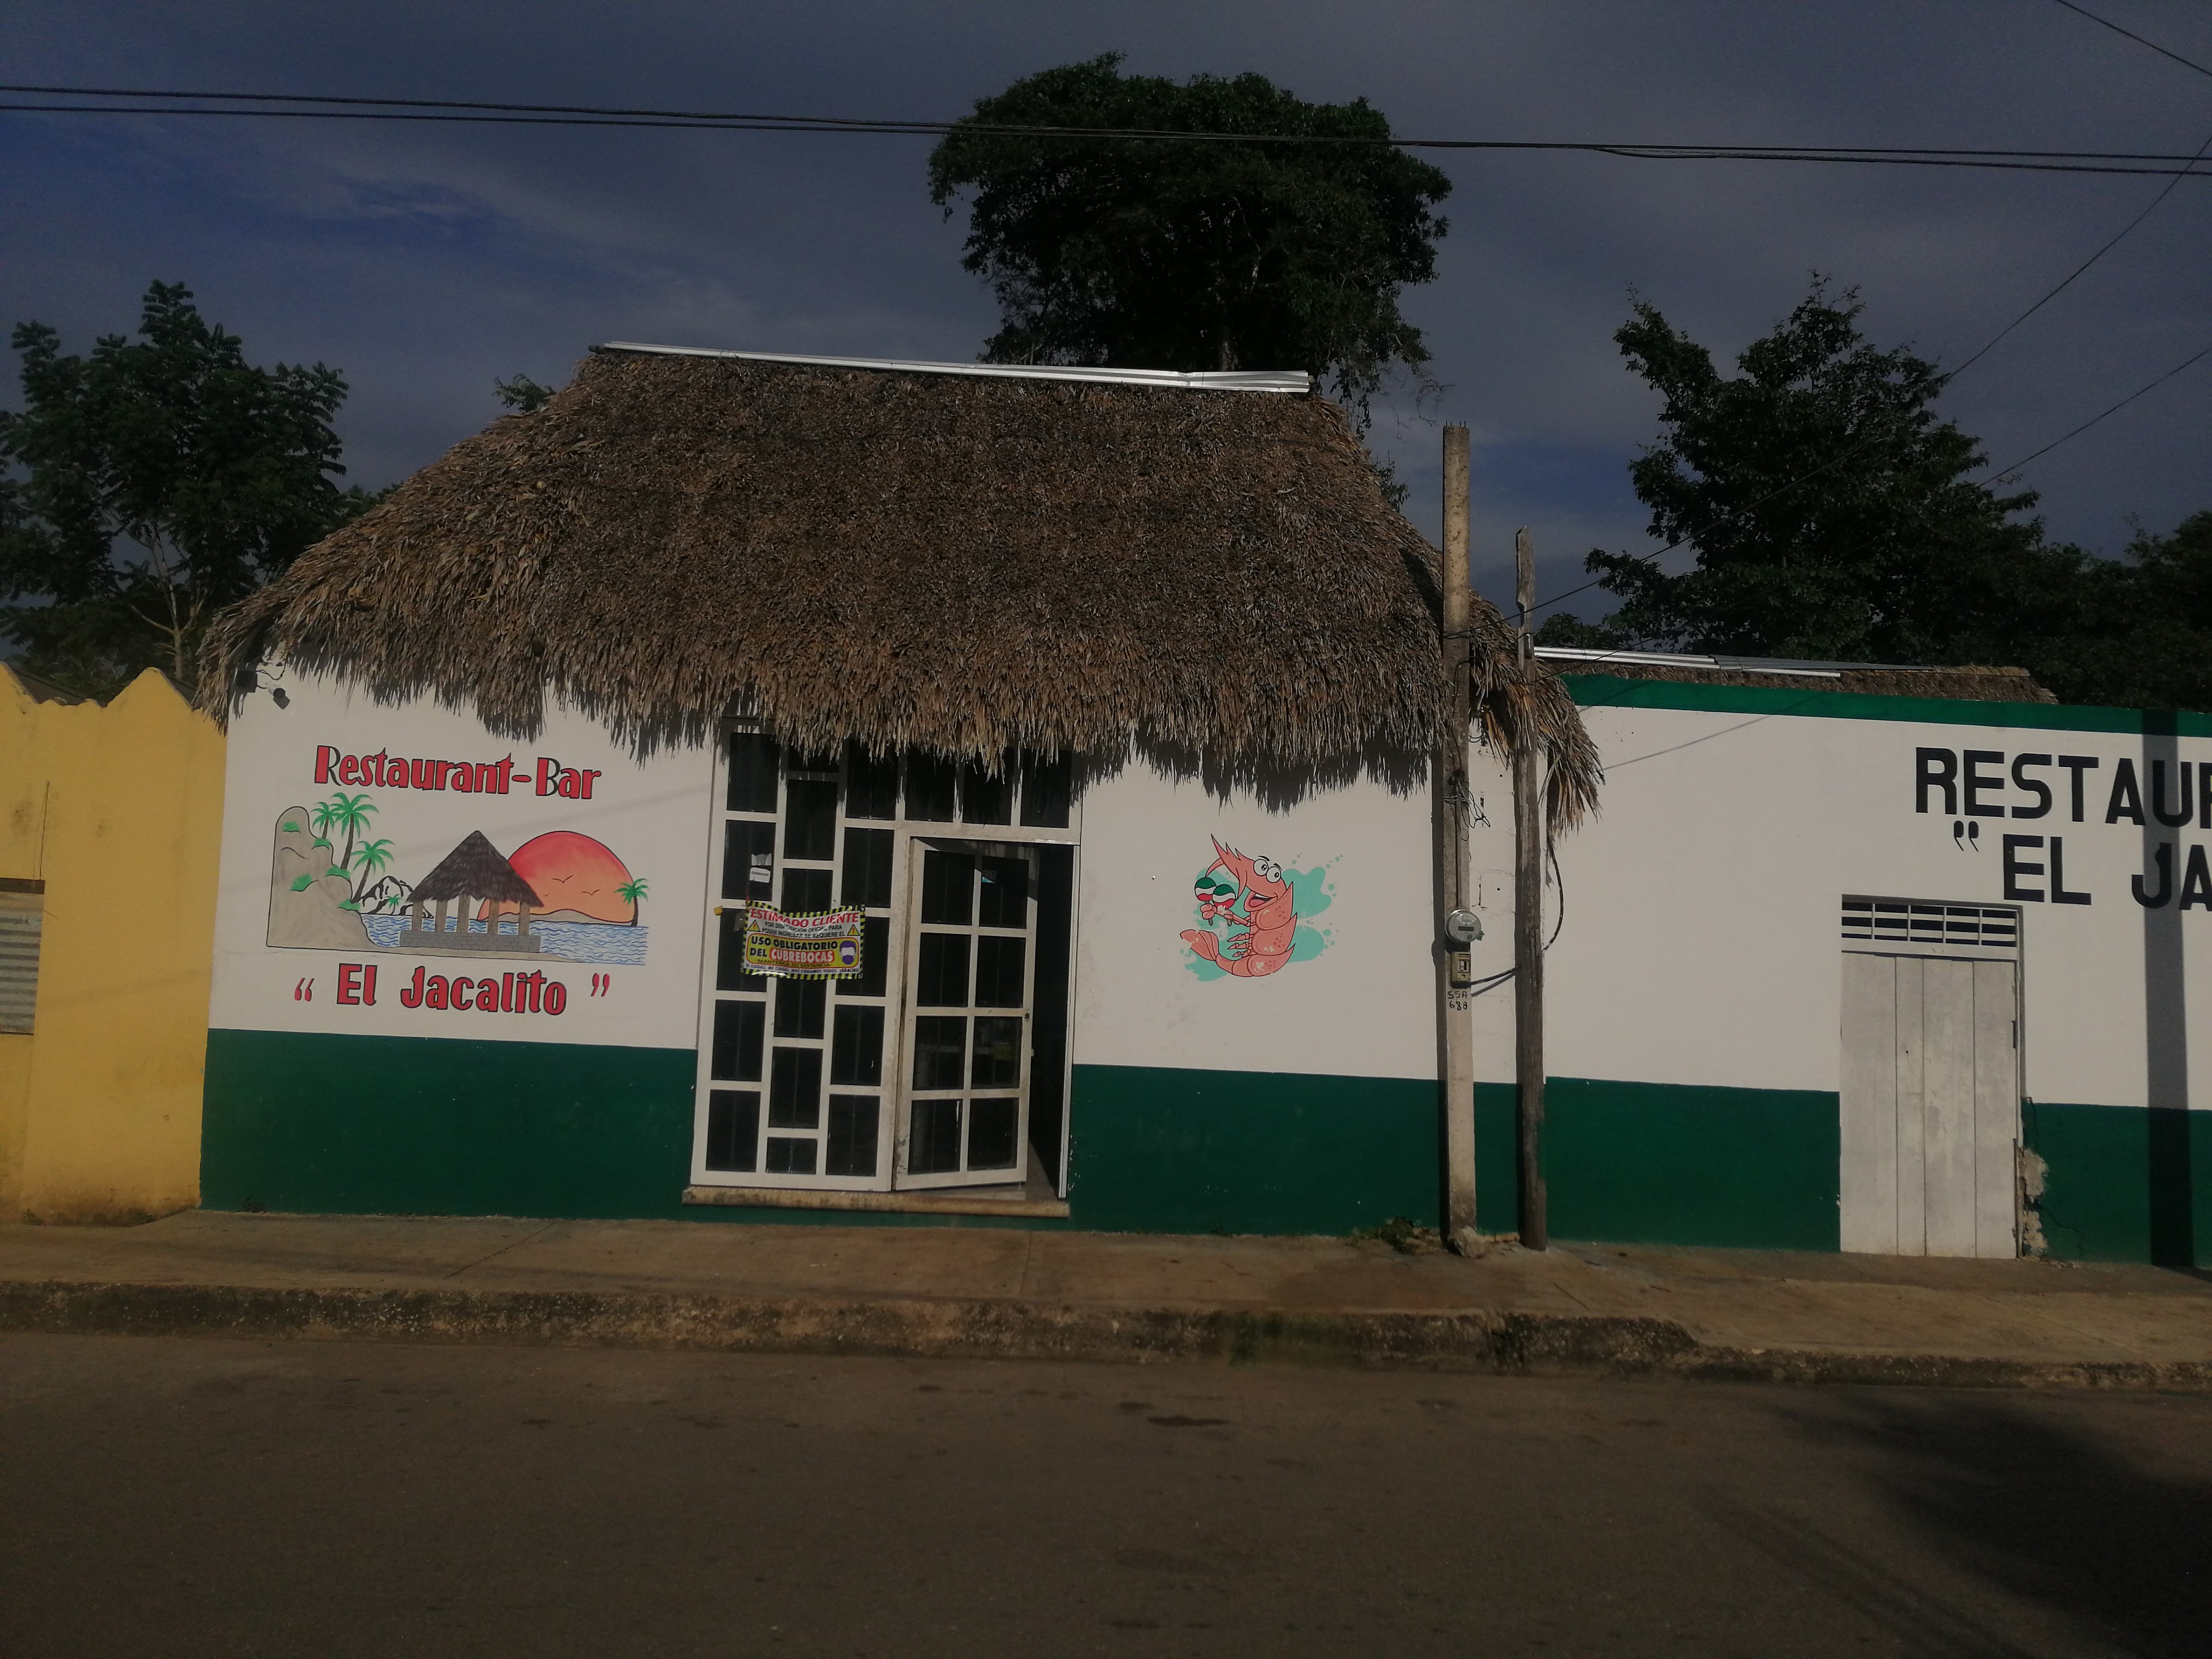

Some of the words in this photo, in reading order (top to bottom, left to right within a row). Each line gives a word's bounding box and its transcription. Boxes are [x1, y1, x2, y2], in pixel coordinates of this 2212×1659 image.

[314, 745, 601, 800] Restaurant-Bar
[2003, 834, 2092, 906] EL
[750, 908, 809, 927] ESTIMADO
[812, 912, 859, 927] CLIENTE
[750, 947, 767, 957] DEL
[771, 948, 833, 963] CUBREBOCAS
[751, 935, 771, 946] USO
[773, 939, 838, 950] OBLIGATORIO
[336, 963, 377, 1007] El
[400, 965, 567, 1016] Jacalito
